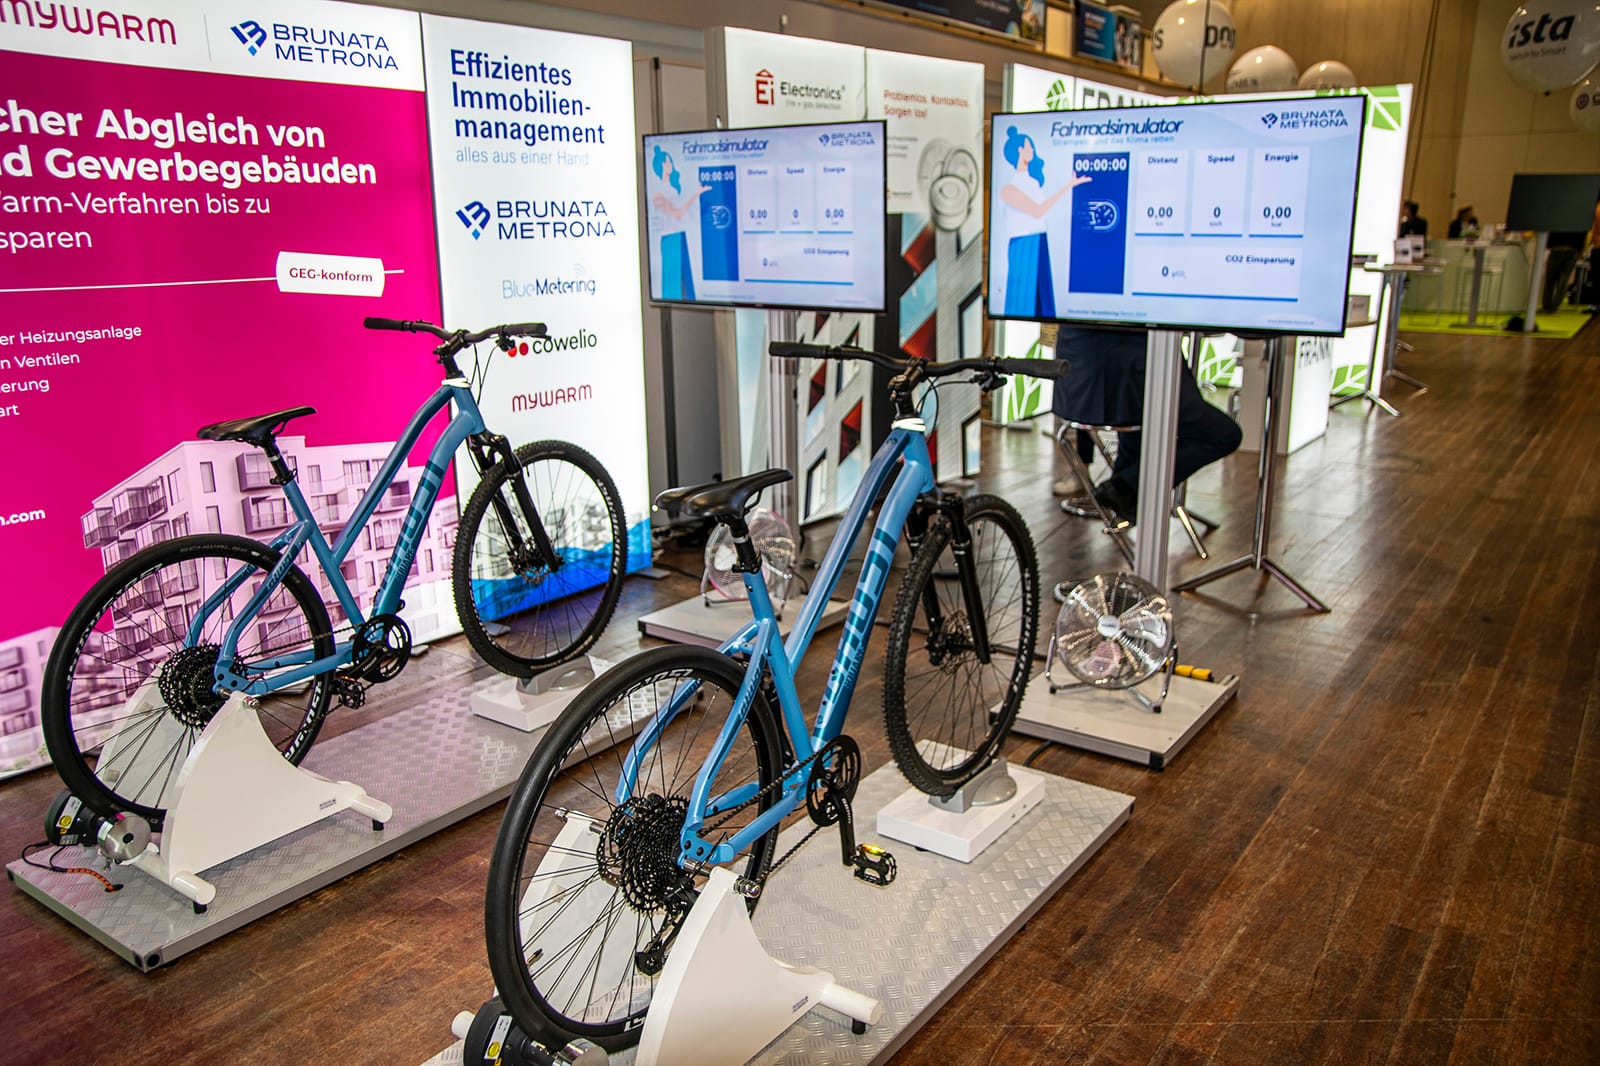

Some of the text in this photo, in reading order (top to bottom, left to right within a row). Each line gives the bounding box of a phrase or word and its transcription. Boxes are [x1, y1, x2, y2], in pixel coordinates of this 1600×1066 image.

[273, 23, 389, 52] BRUNATA
[1509, 13, 1576, 49] ista
[275, 43, 399, 71] METRONA
[450, 49, 572, 86] Effizientes
[452, 82, 591, 116] Immobilien-
[755, 79, 775, 106] Ei
[1279, 117, 1349, 129] METRONA
[1280, 109, 1345, 120] BRUNATA
[96, 109, 258, 149] Abgleich
[266, 122, 325, 148] von
[455, 118, 605, 146] management
[1050, 117, 1184, 137] Fahrradsimulator
[682, 138, 769, 155] Fahrradsimulator
[456, 146, 589, 166] alles aus einer Hand
[1075, 158, 1127, 171] 00:00:00
[1147, 156, 1178, 164] Distanz
[1207, 154, 1235, 164] Speed
[1264, 153, 1299, 163] Energie
[45, 147, 377, 189] Gewerbegebäuden
[0, 190, 271, 214] arm-Verfahren bis zu
[496, 200, 608, 218] BRUNATA
[792, 209, 799, 219] 0
[1147, 206, 1173, 219] 0,00
[1213, 206, 1221, 218] 0
[1263, 206, 1291, 220] 0,00
[498, 221, 616, 240] METRONA
[0, 231, 92, 254] sparen
[1225, 255, 1295, 265] CO2 Einsparung
[289, 267, 373, 284] GEG-konform
[1161, 265, 1169, 277] 0
[502, 278, 596, 299] BlueMetering
[20, 325, 142, 345] Heizungsanlage
[532, 329, 597, 354] cowelio
[14, 352, 80, 368] Ventilen
[0, 378, 50, 393] erung
